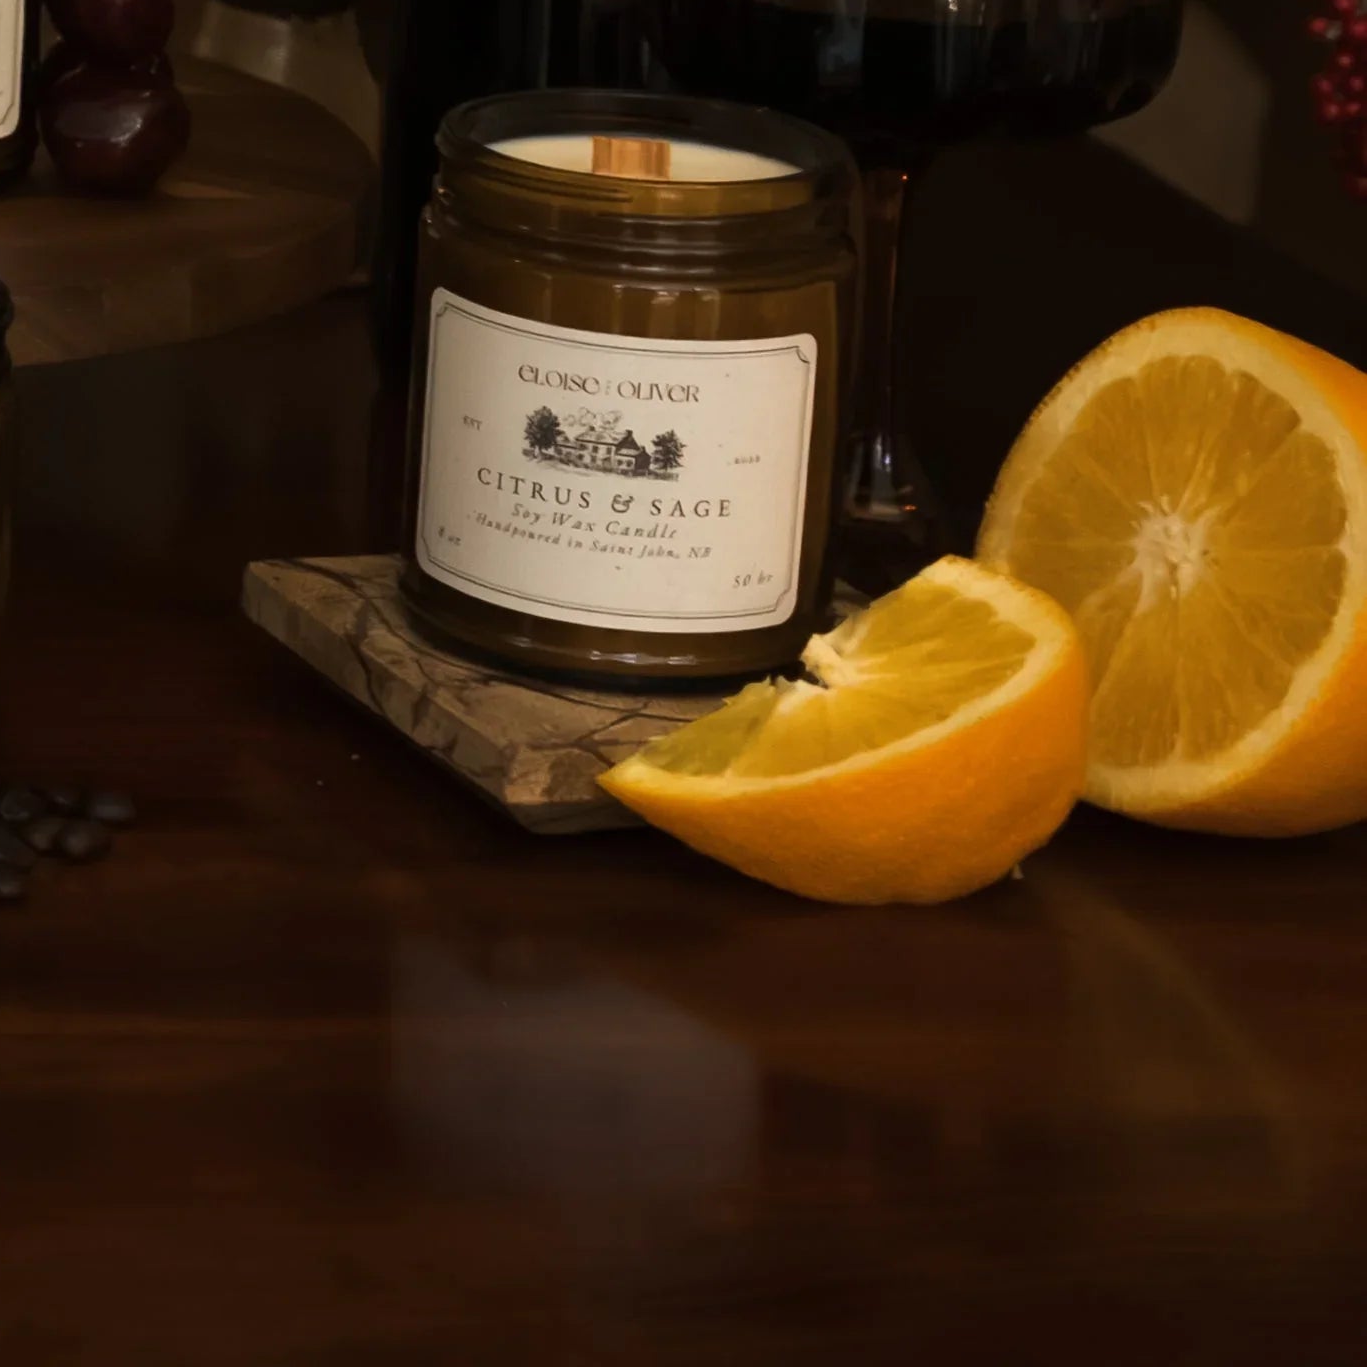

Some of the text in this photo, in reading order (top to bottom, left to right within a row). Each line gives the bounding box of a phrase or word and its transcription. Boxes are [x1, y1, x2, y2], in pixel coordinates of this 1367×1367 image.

[617, 380, 700, 403] OLIVER
[476, 467, 732, 518] CITRUS & SAGE
[474, 510, 561, 546] Handpoured
[568, 533, 584, 549] in
[589, 539, 634, 557] Saint
[687, 545, 712, 559] NB
[512, 502, 678, 539] Soy Wax Candle
[732, 571, 753, 589] 50
